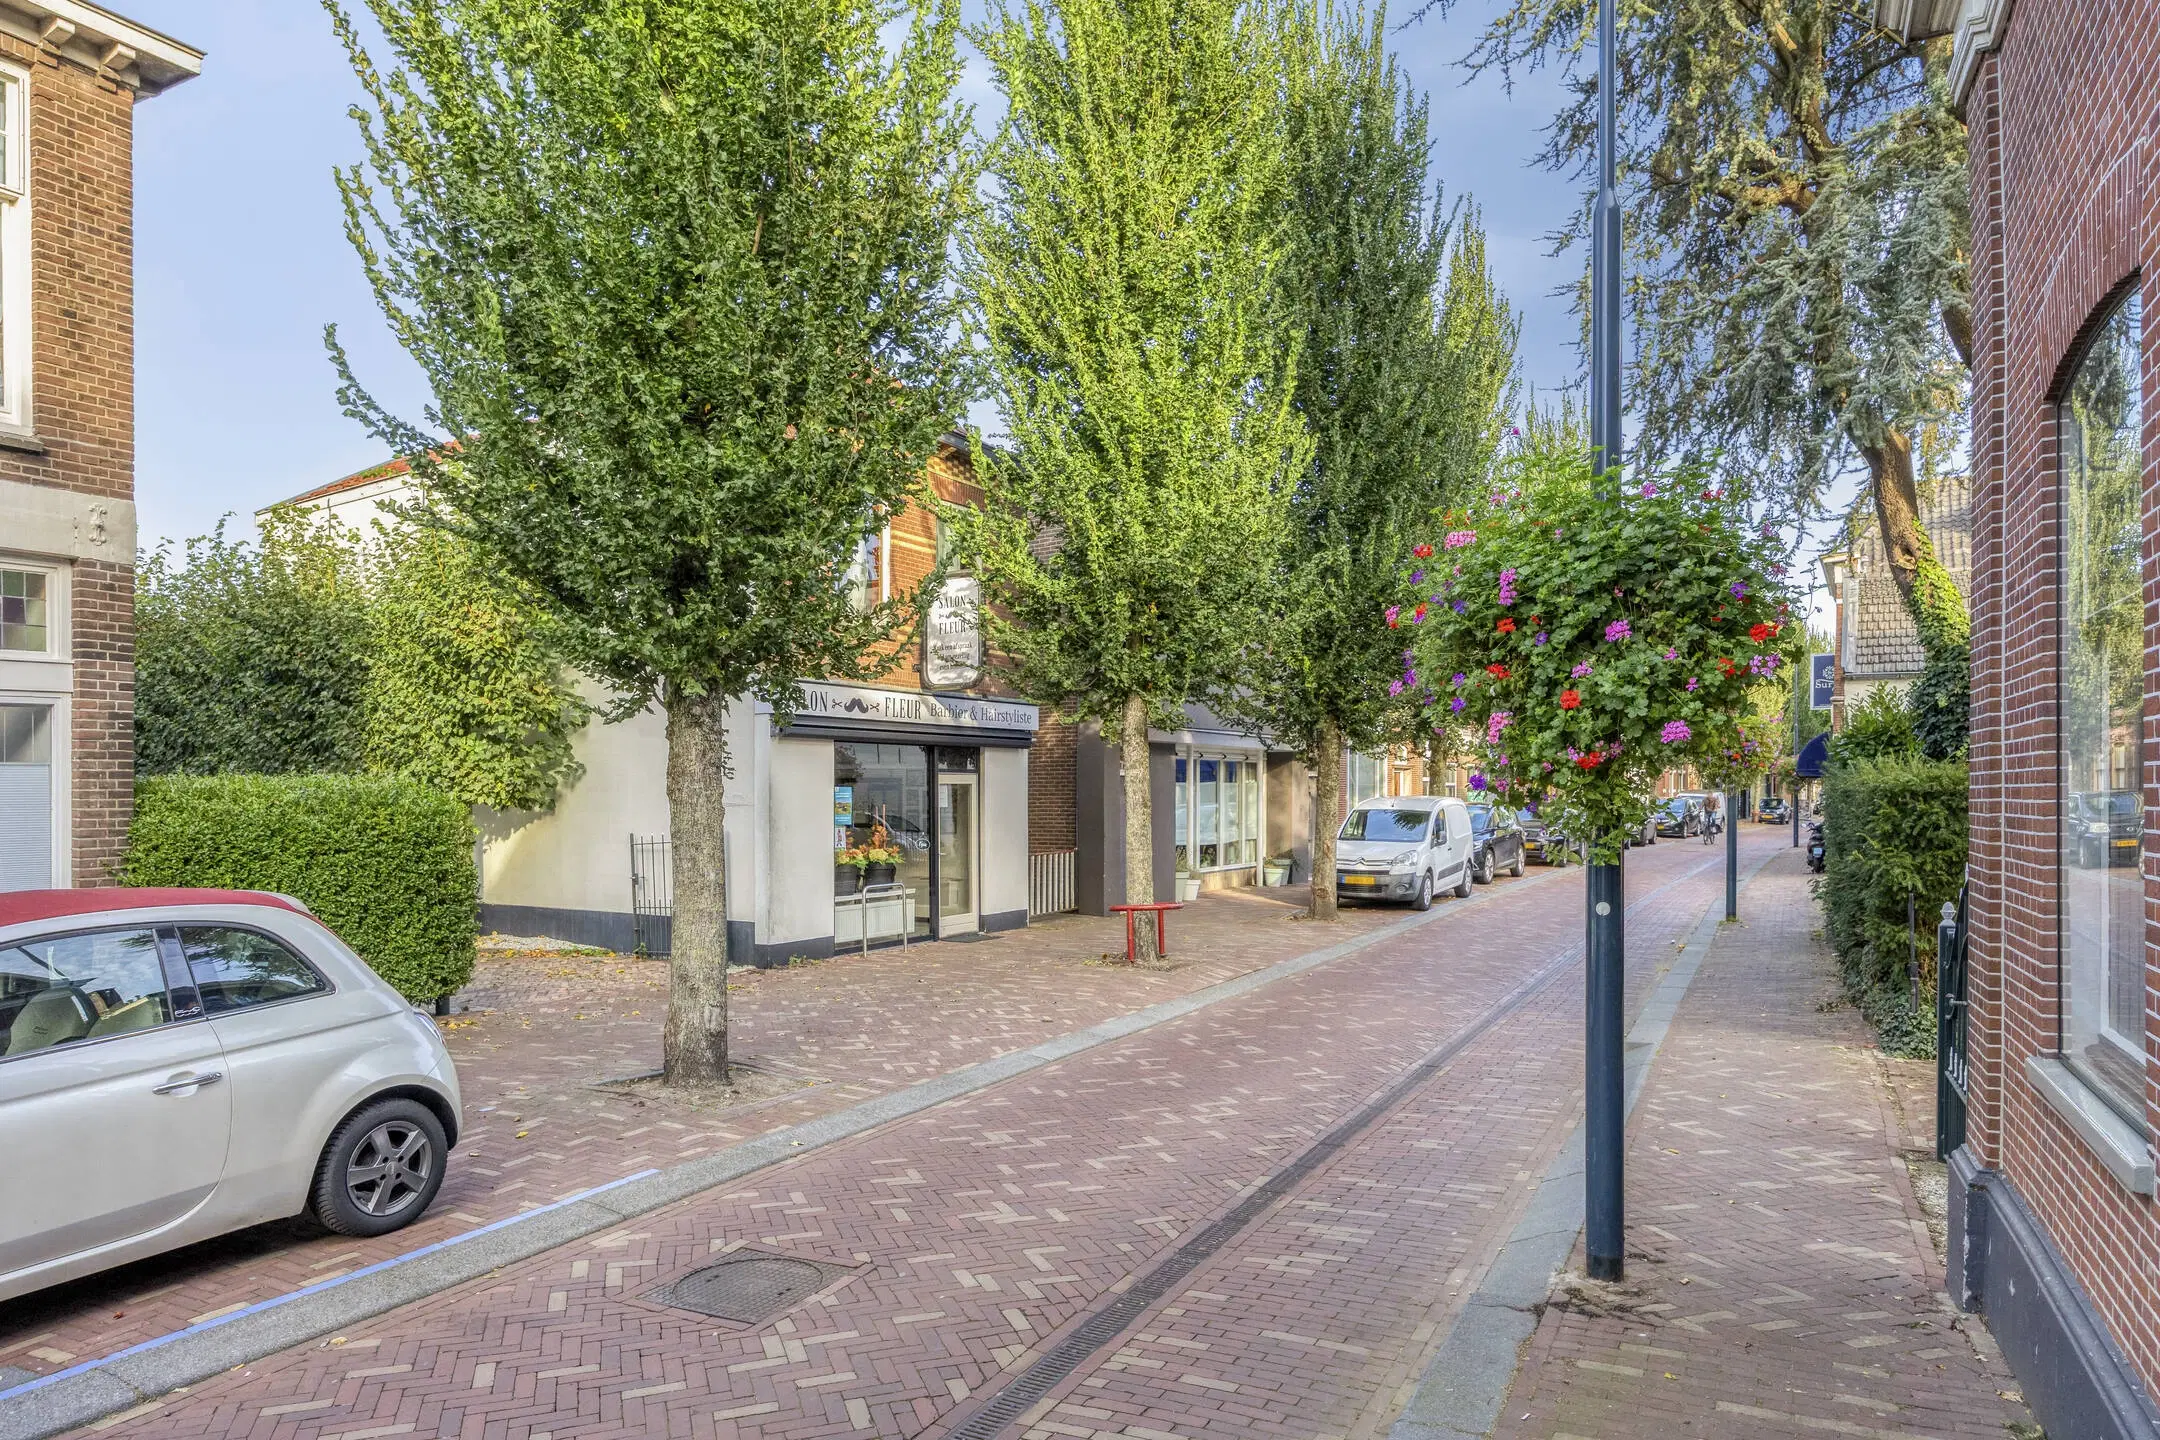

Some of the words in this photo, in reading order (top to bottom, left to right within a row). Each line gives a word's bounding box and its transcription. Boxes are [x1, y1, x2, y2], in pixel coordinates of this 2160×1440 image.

[938, 596, 966, 609] SALON
[939, 622, 966, 635] FLEUR
[885, 696, 921, 720] FLEUR
[930, 701, 969, 719] Barbier
[970, 704, 978, 720] &
[981, 706, 1032, 726] Hairstyliste
